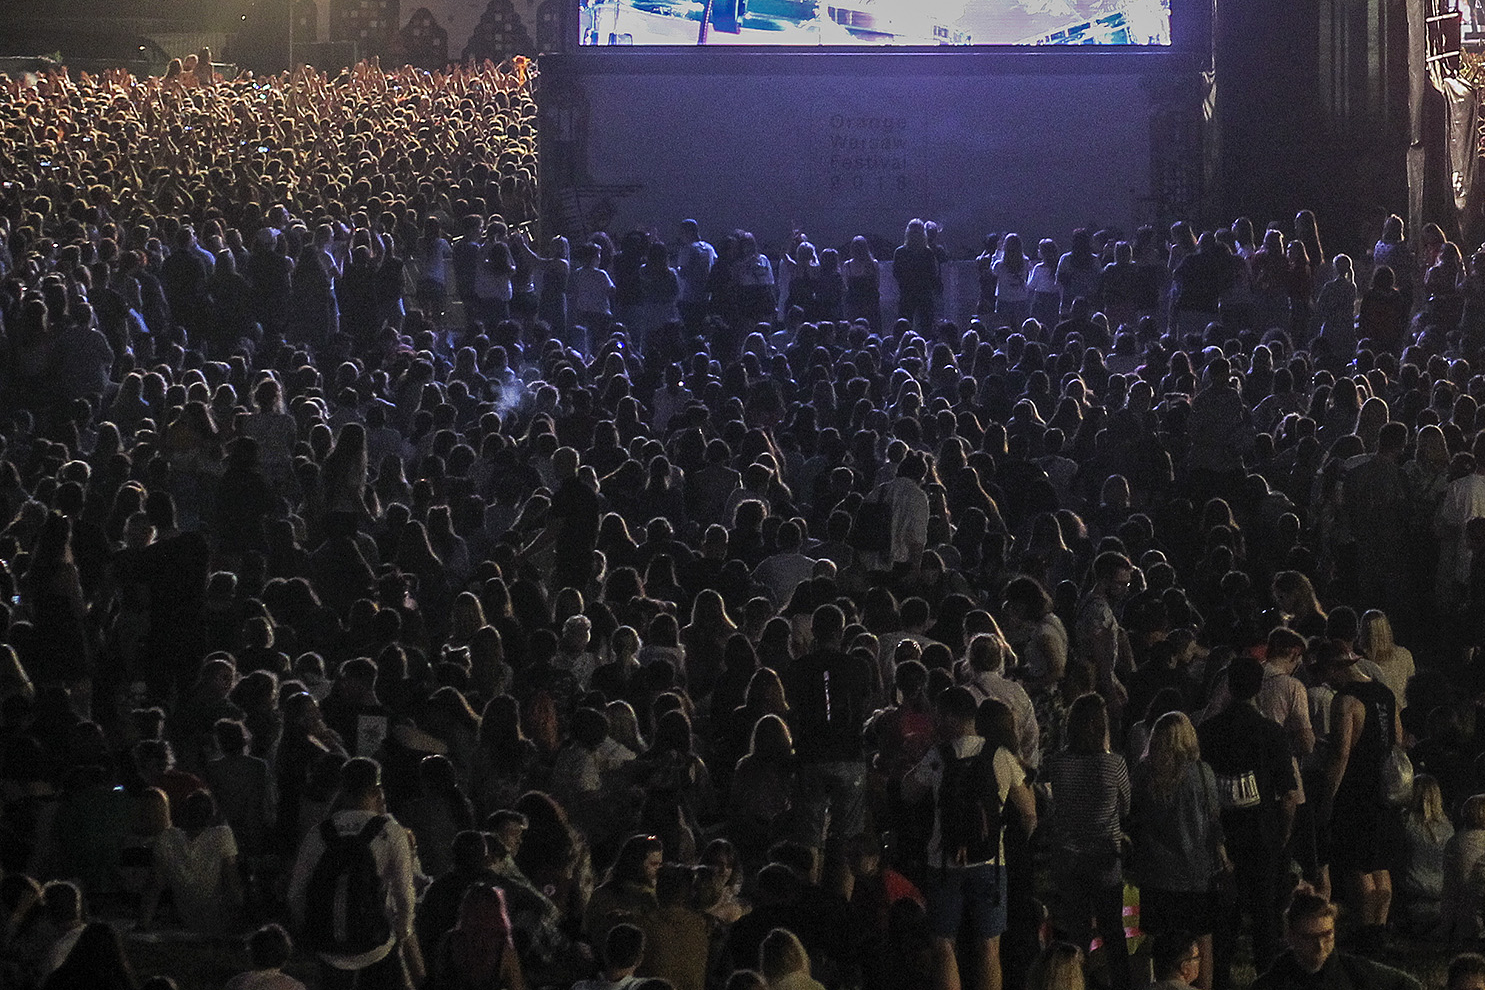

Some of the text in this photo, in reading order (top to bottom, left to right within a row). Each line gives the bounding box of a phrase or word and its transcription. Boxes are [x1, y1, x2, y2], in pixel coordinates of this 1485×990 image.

[828, 113, 908, 132] Orange
[828, 134, 907, 150] Warsaw
[829, 153, 907, 170] Festival
[829, 174, 908, 191] 2018
